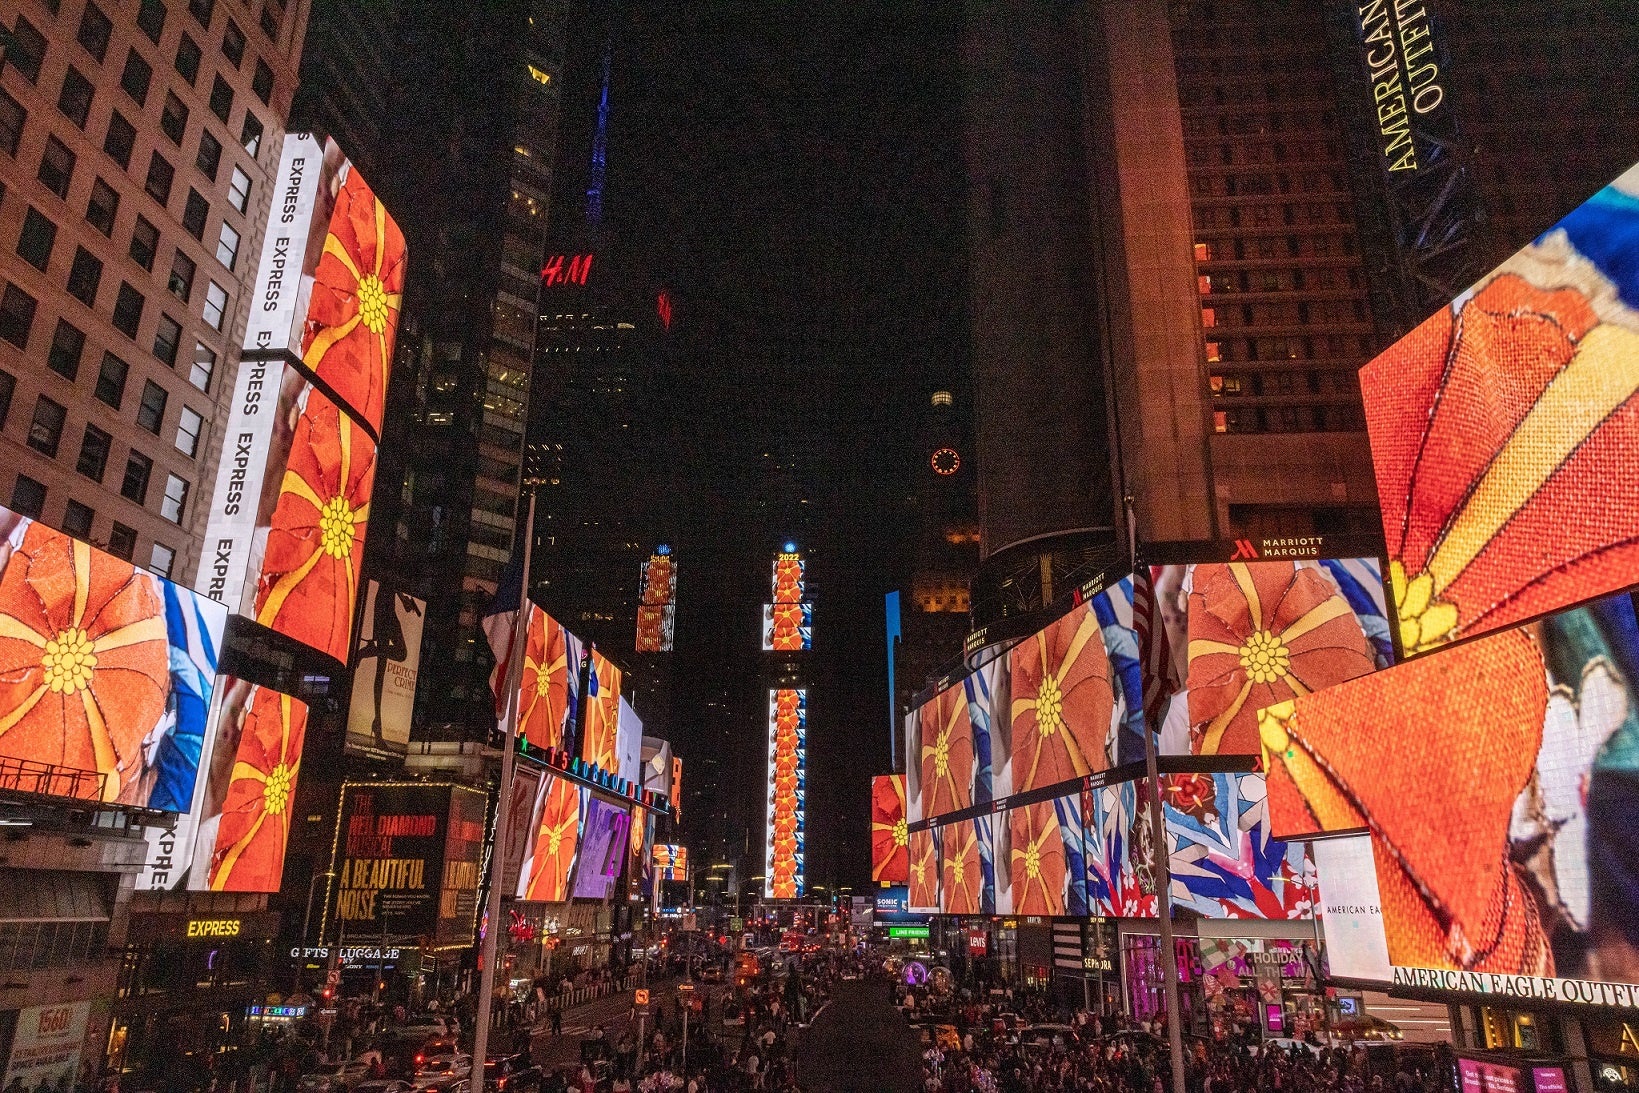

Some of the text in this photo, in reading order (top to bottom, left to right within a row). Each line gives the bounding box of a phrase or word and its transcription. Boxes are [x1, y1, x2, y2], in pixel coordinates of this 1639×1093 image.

[1359, 0, 1417, 172] AMERICAN
[281, 158, 305, 223] EXPRESS
[263, 237, 290, 311] EXPRESS
[224, 433, 253, 516] EXPRESS
[1263, 538, 1323, 547] MARRIOTT
[778, 553, 800, 561] 2022
[1264, 548, 1317, 556] MARQUIS
[1082, 572, 1105, 591] MARRIOTT
[1083, 584, 1103, 600] MARQUIS
[387, 662, 417, 680] PERFECT
[340, 859, 351, 889] A
[352, 859, 425, 890] BEAUTIFUL
[335, 890, 378, 920] NOISE
[1327, 906, 1382, 914] AMERICAN EA
[187, 920, 240, 937] EXPRESS
[290, 947, 400, 959] GFTS LUGGAGE
[1253, 952, 1303, 964] HOLIDAY
[1392, 967, 1639, 1008] AMERICAN EAGLE OUTFI
